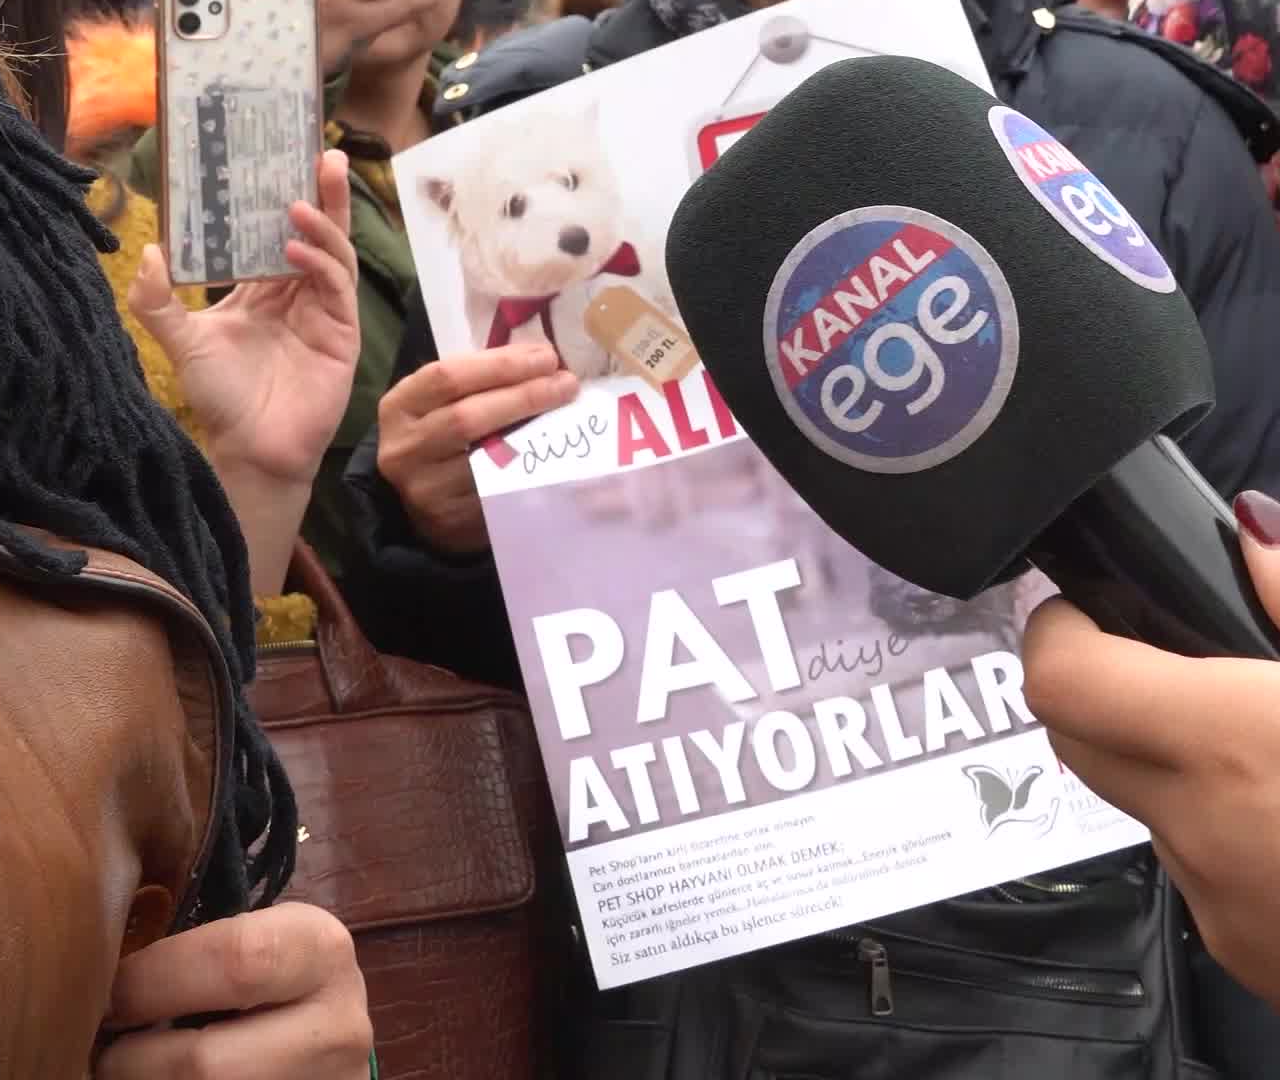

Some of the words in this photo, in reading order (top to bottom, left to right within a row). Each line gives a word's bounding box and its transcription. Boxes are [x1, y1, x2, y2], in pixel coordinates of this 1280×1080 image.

[780, 239, 937, 376] KANAL
[645, 348, 665, 369] 200
[821, 275, 989, 433] ege
[523, 414, 608, 474] diye
[532, 558, 803, 742] PAT
[808, 632, 910, 683] diye
[567, 650, 1038, 842] ATIYORLAR
[589, 866, 605, 876] Pet
[598, 897, 622, 912] PET
[626, 886, 665, 905] SHOP
[670, 869, 731, 893] HAYVANI
[737, 855, 786, 876] OLMAK
[610, 951, 630, 965] Siz
[634, 943, 666, 959] satın
[670, 927, 719, 952] aldıkça
[721, 922, 738, 936] bu
